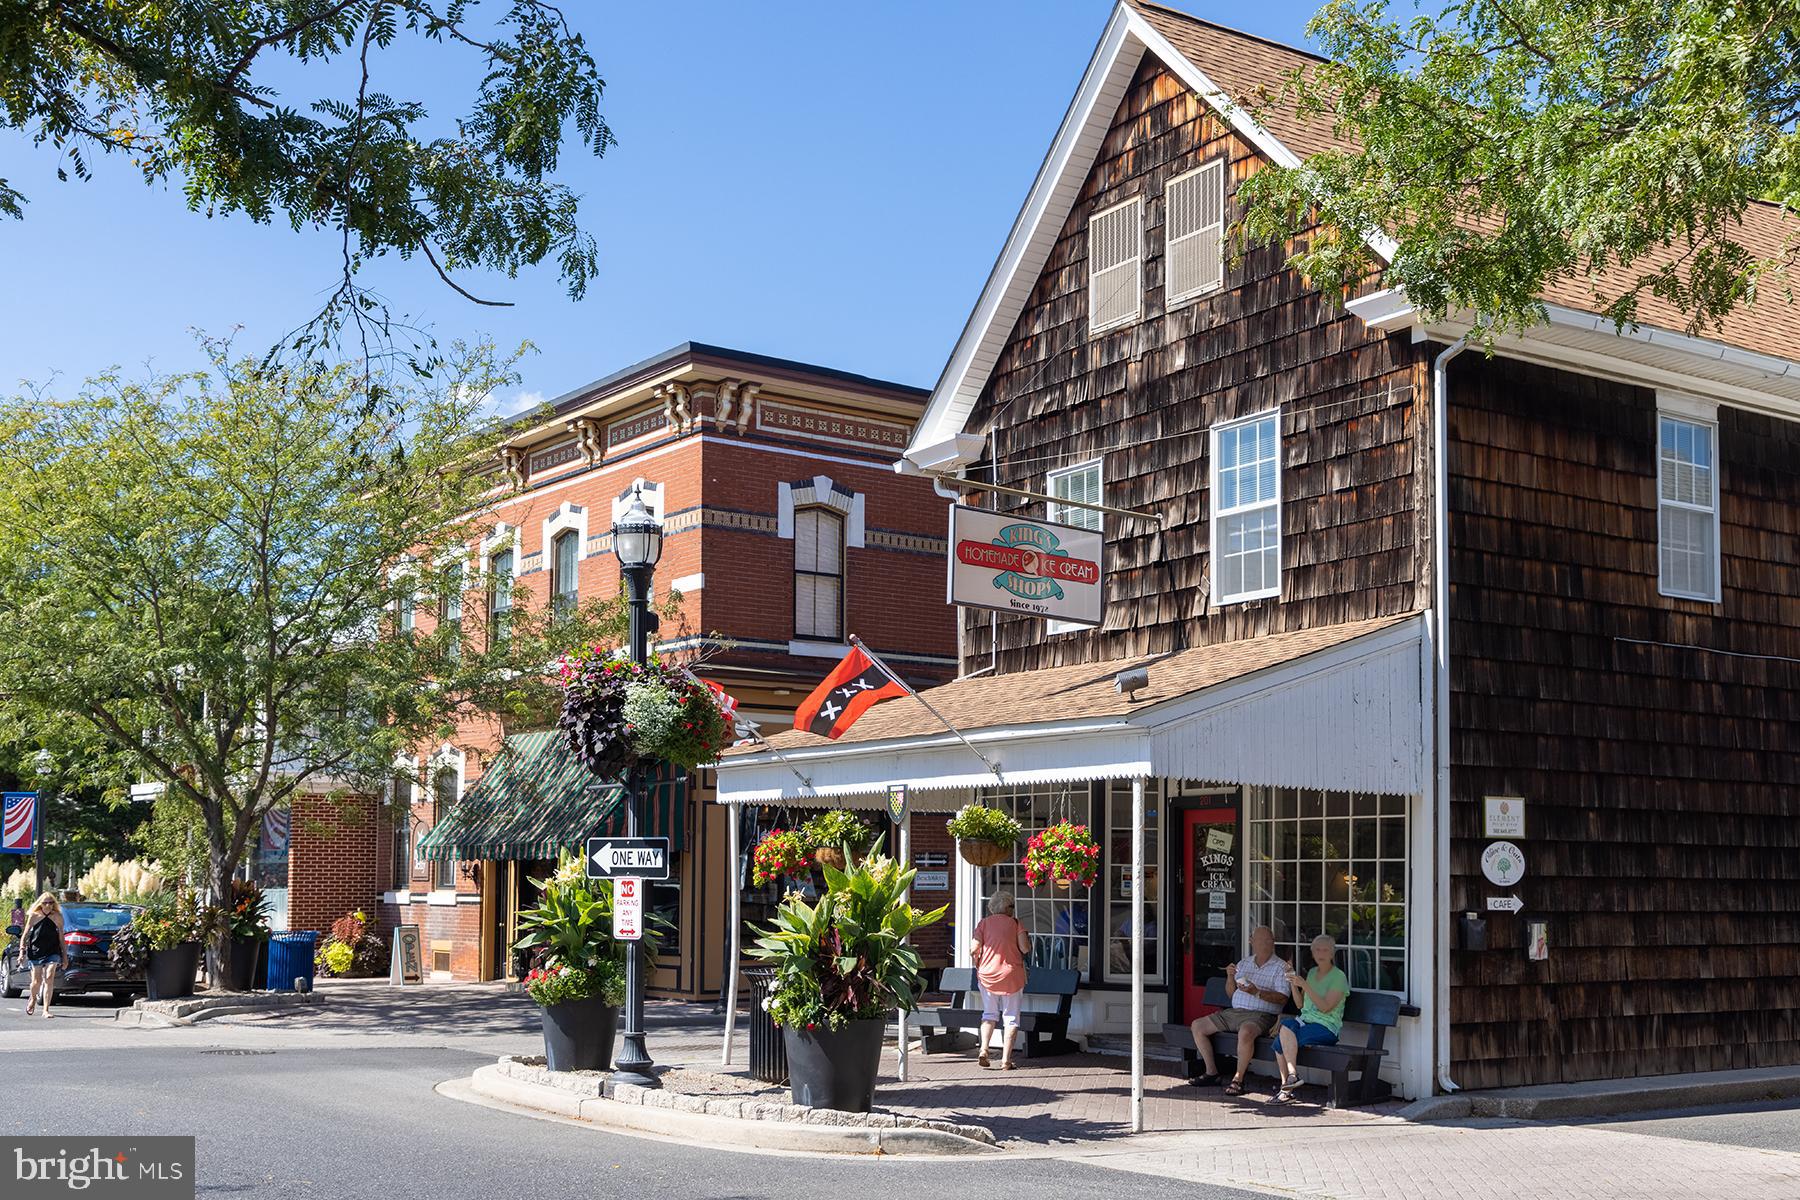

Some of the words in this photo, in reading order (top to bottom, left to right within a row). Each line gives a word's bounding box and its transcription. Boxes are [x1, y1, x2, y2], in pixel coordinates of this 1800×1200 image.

[965, 546, 1020, 568] HOMEMADE
[1041, 559, 1056, 574] ICE
[1059, 561, 1094, 579] CREAM
[1008, 576, 1051, 596] SHOPS
[1010, 599, 1030, 610] Since
[612, 851, 633, 866] ONE
[637, 851, 660, 866] WAY
[1200, 853, 1235, 867] KINGS
[1210, 872, 1225, 881] ICE
[621, 884, 635, 895] NO
[1201, 880, 1233, 889] CREAM
[616, 899, 639, 907] PARKING
[1493, 900, 1512, 909] CAFE
[621, 919, 634, 927] TIME
